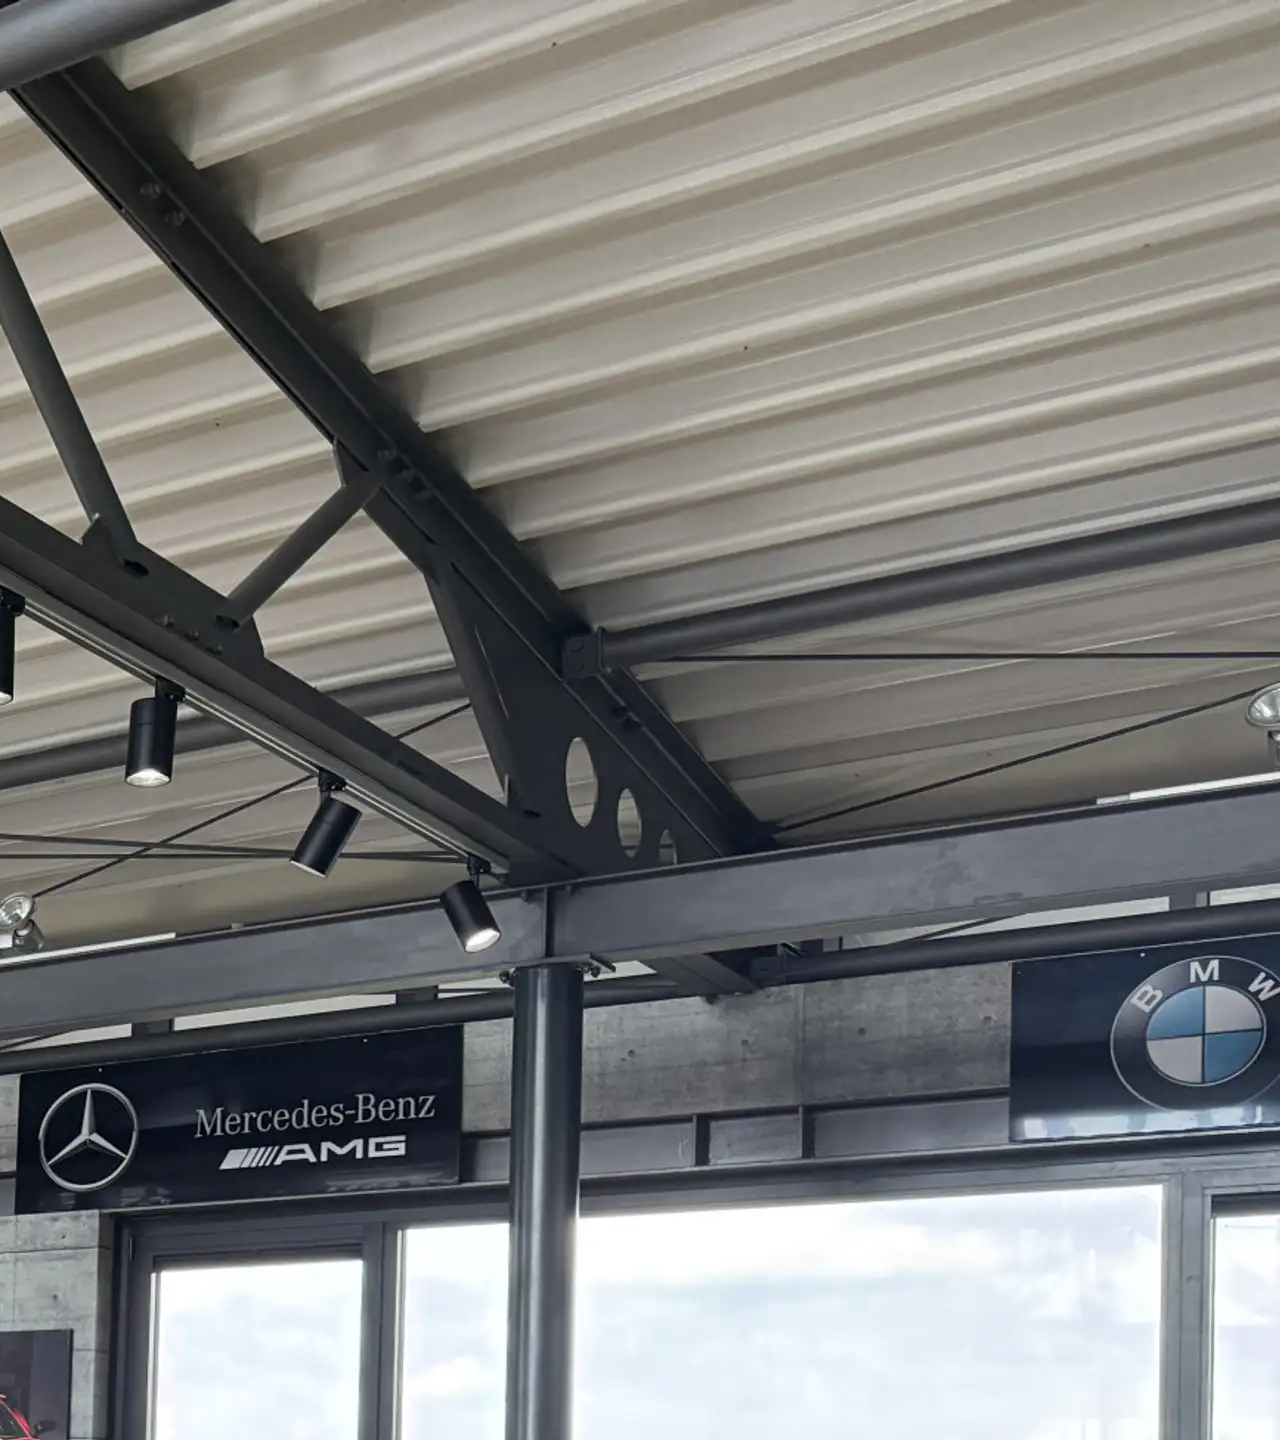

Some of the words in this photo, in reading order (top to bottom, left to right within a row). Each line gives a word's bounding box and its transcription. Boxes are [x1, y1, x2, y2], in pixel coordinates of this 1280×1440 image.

[1130, 959, 1280, 1013] BMW
[194, 1093, 436, 1138] Mercedes-Benz
[273, 1135, 406, 1166] AMG
